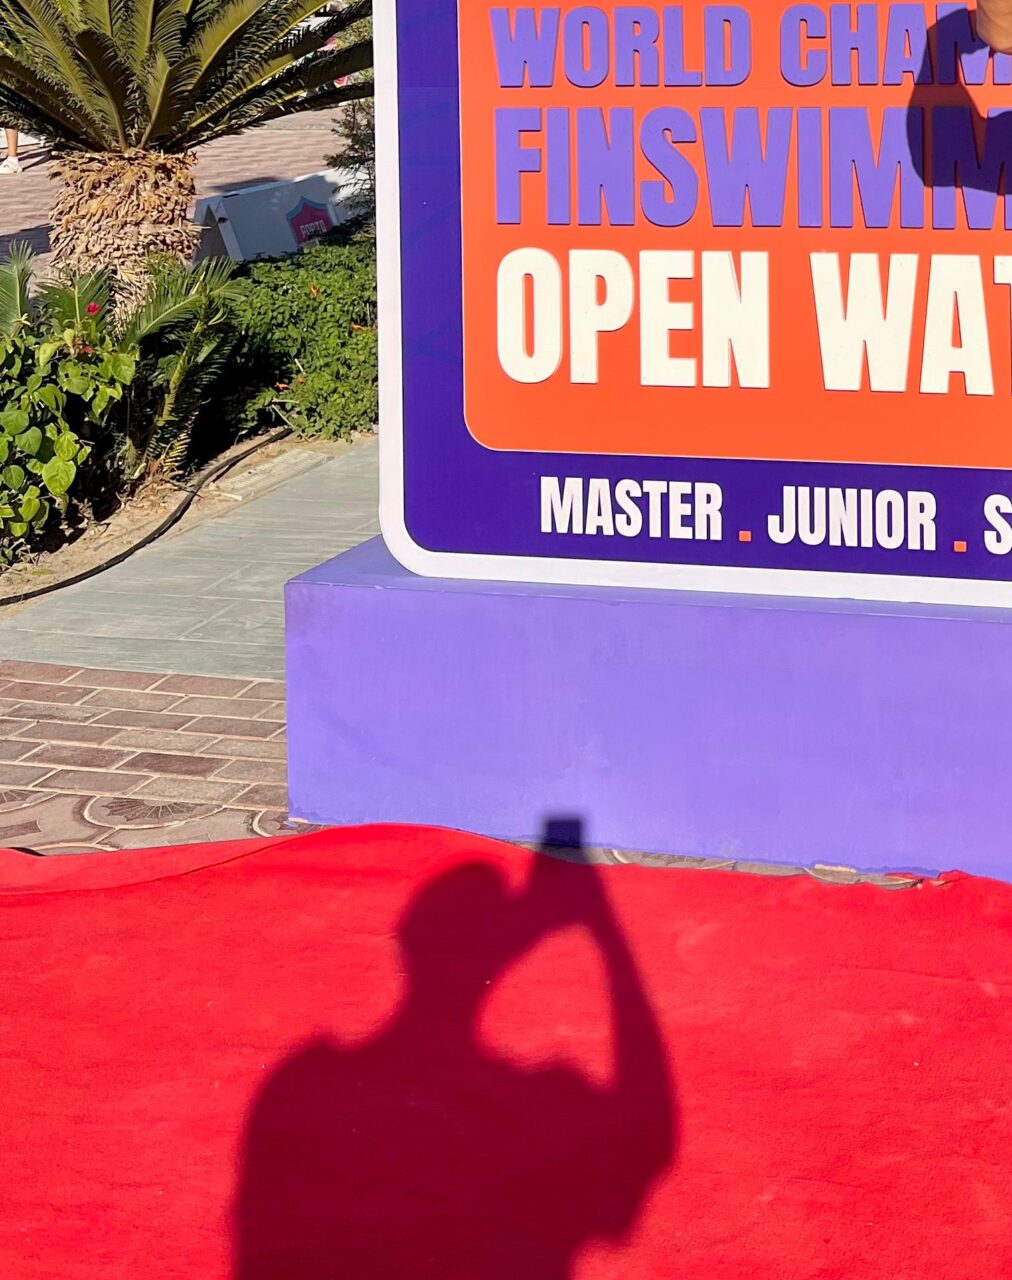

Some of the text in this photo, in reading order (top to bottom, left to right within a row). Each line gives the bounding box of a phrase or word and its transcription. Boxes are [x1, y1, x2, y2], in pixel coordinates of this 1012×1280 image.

[488, 4, 752, 89] WORLD
[496, 246, 770, 389] OPEN
[540, 476, 722, 542] MASTER
[767, 485, 937, 551] JUNIOR
